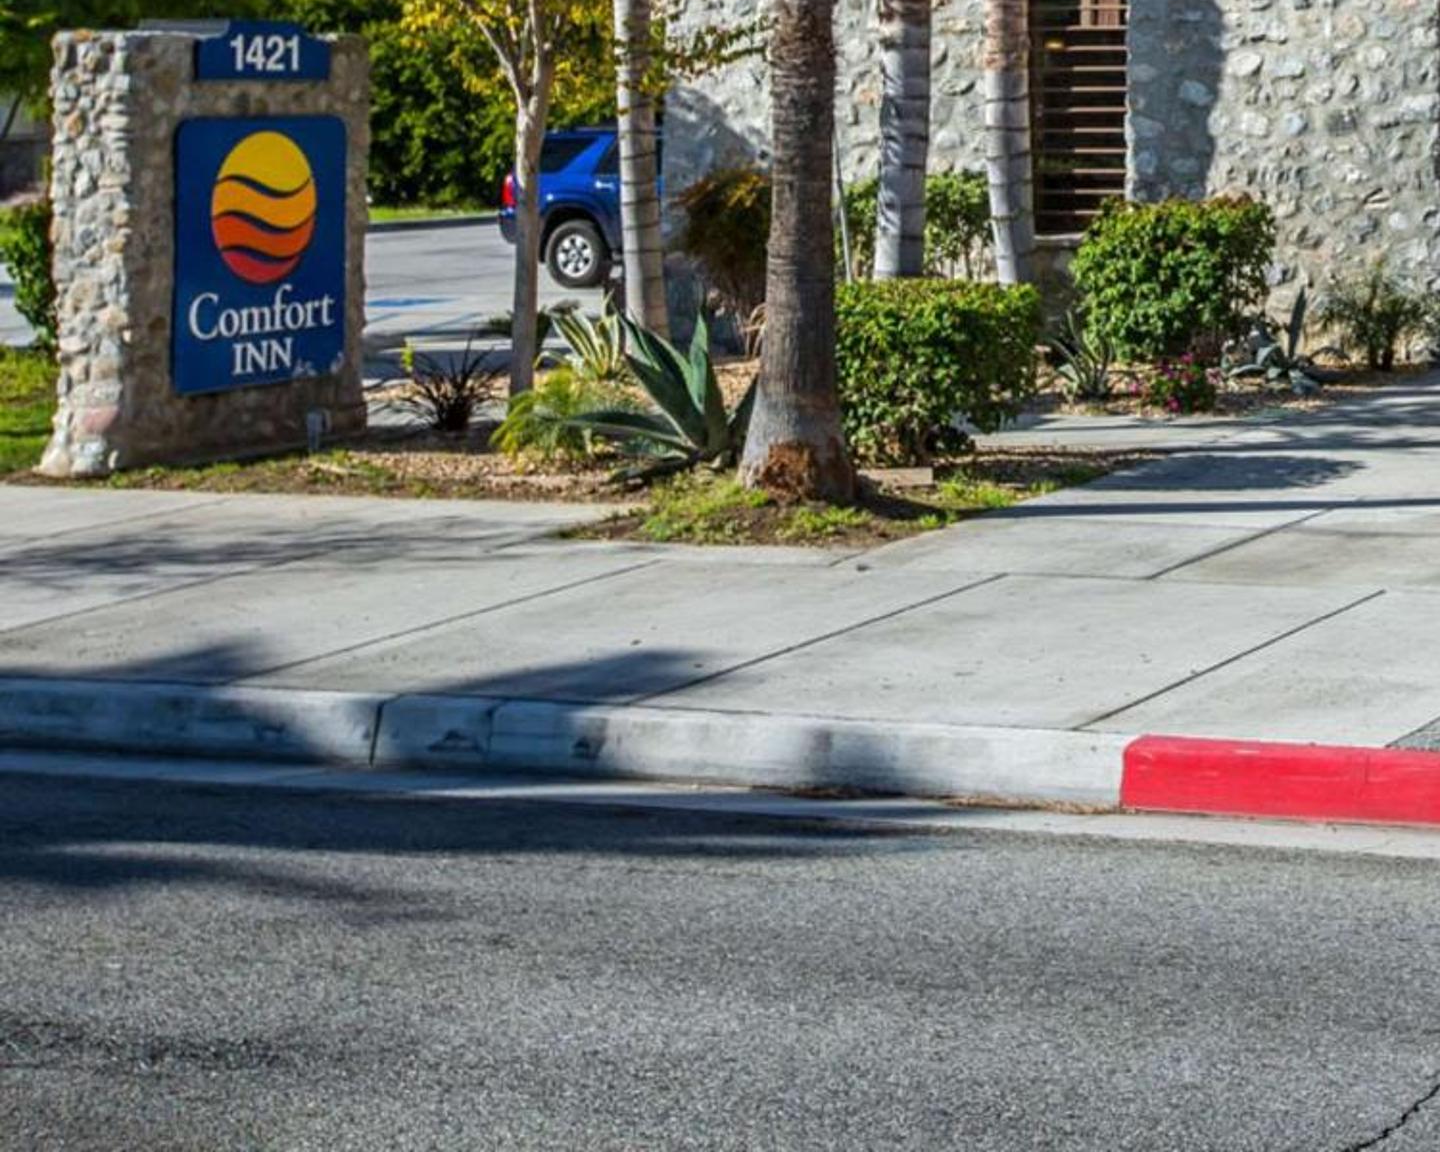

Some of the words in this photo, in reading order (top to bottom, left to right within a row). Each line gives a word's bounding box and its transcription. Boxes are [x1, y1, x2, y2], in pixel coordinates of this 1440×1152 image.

[230, 34, 299, 71] 1421
[189, 284, 335, 340] Comfort
[232, 337, 293, 376] INN
